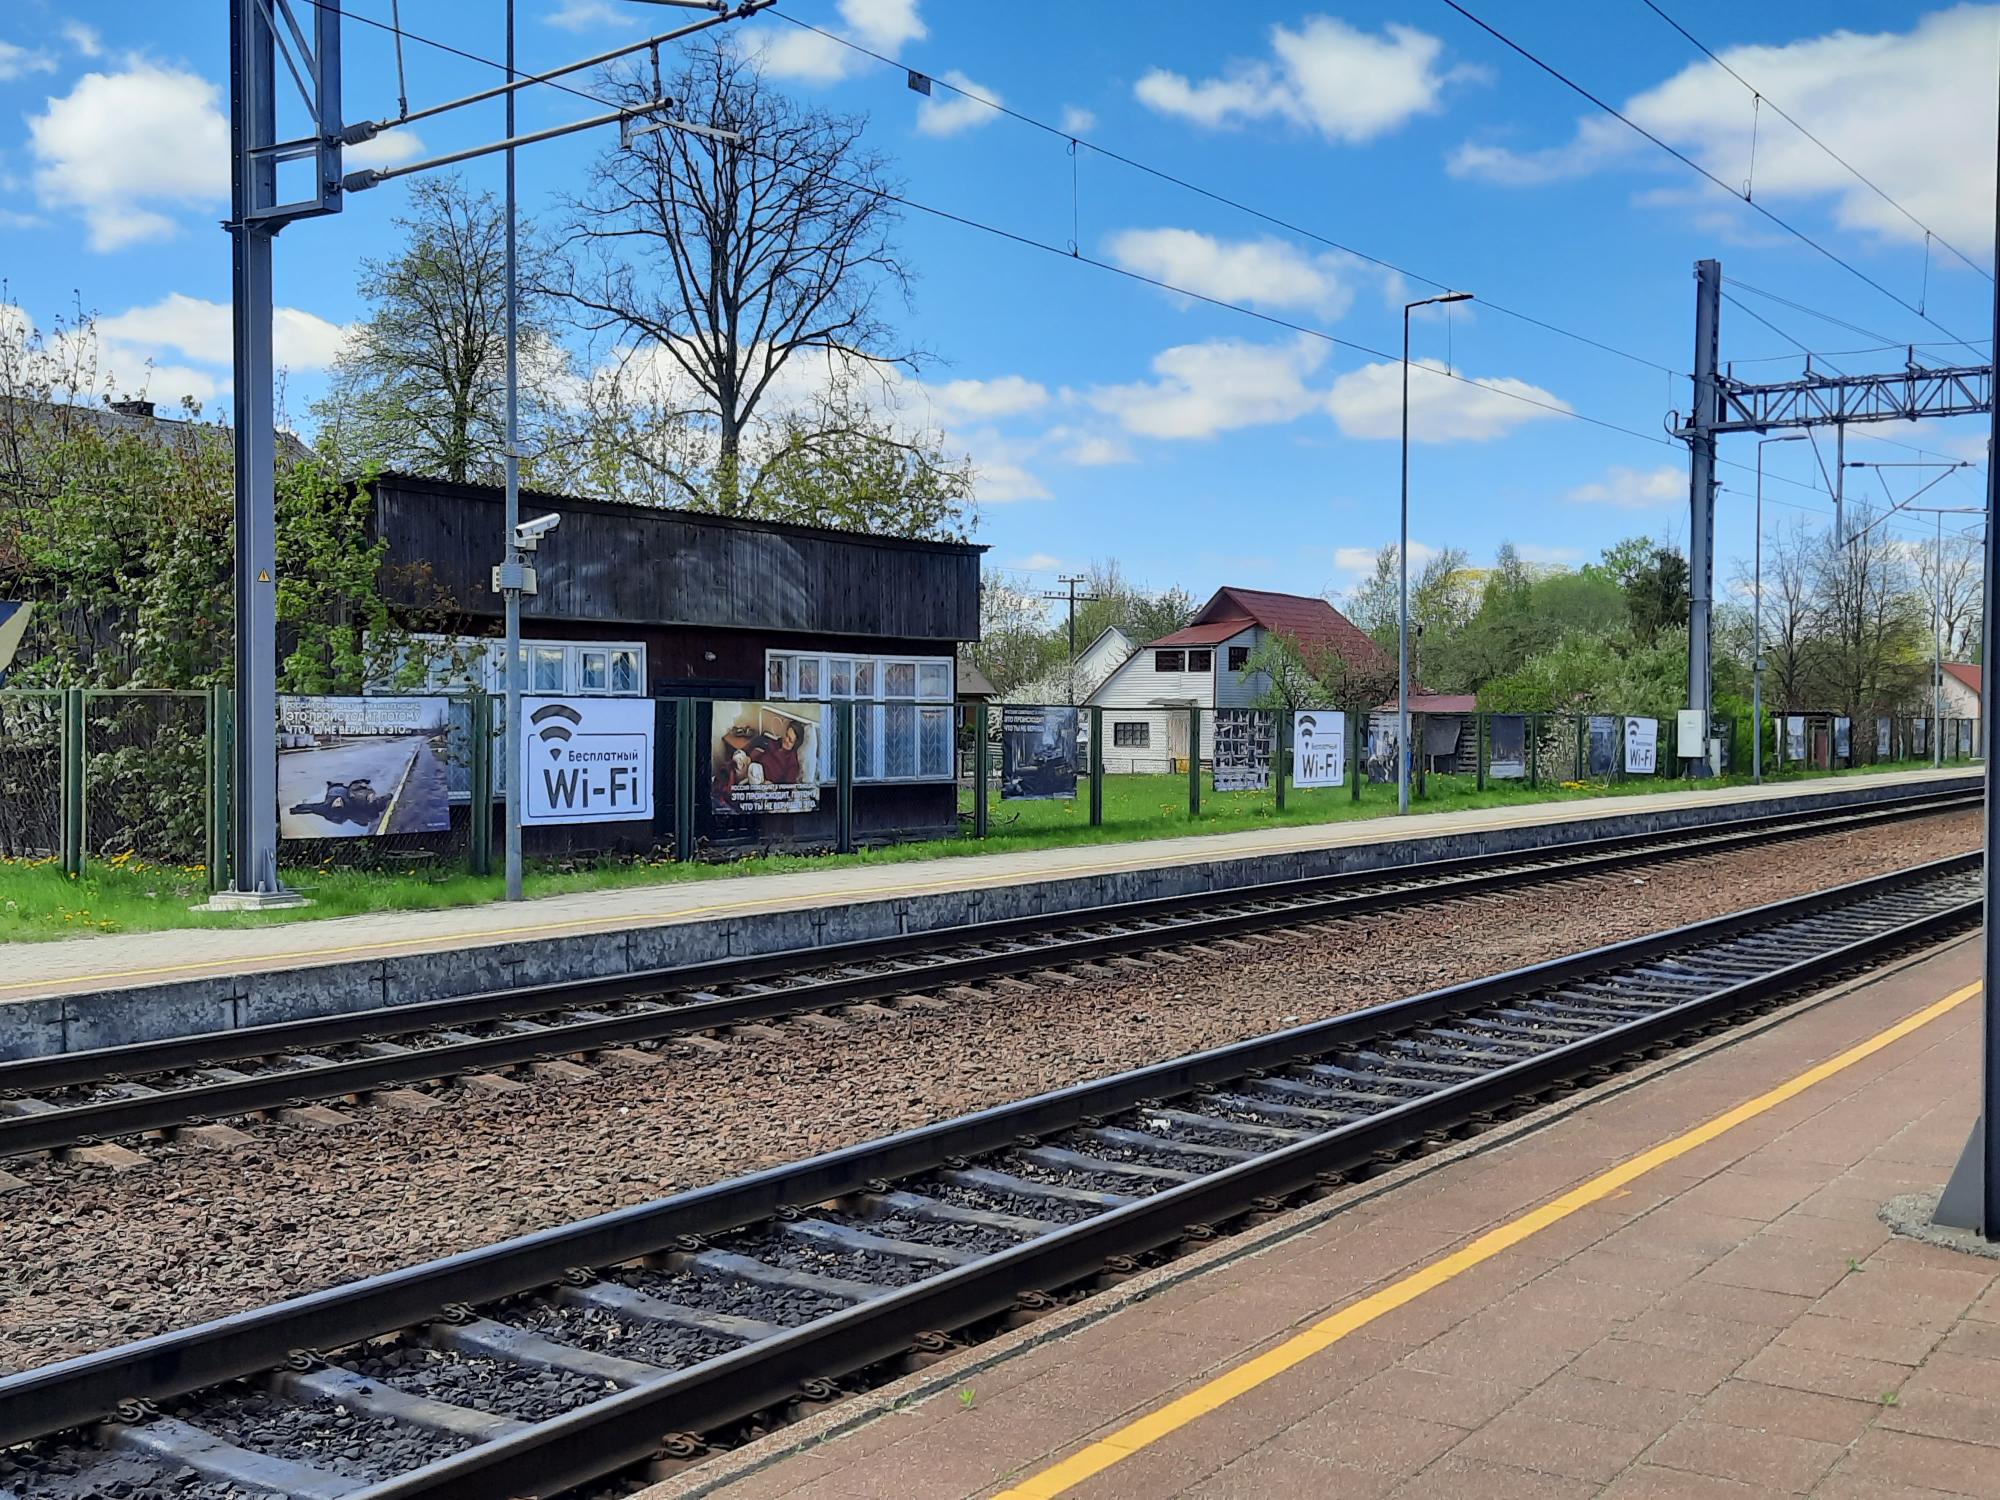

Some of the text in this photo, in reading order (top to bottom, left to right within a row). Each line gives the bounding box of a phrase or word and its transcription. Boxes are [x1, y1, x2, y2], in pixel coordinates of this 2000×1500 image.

[286, 711, 307, 722] ЭТО
[381, 711, 421, 722] ПОТОМУ
[285, 725, 306, 735] ЧТО
[308, 724, 323, 735] ТЫ
[324, 724, 336, 735] НЕ
[339, 724, 377, 735] ВЕРИШЬ
[379, 725, 385, 735] В
[568, 749, 639, 762] Бесплатный
[1630, 749, 1652, 767] Wi-Fi
[1302, 753, 1337, 778] Wi-Fi
[543, 766, 638, 809] Wi-Fi
[740, 802, 754, 811] ЧТО
